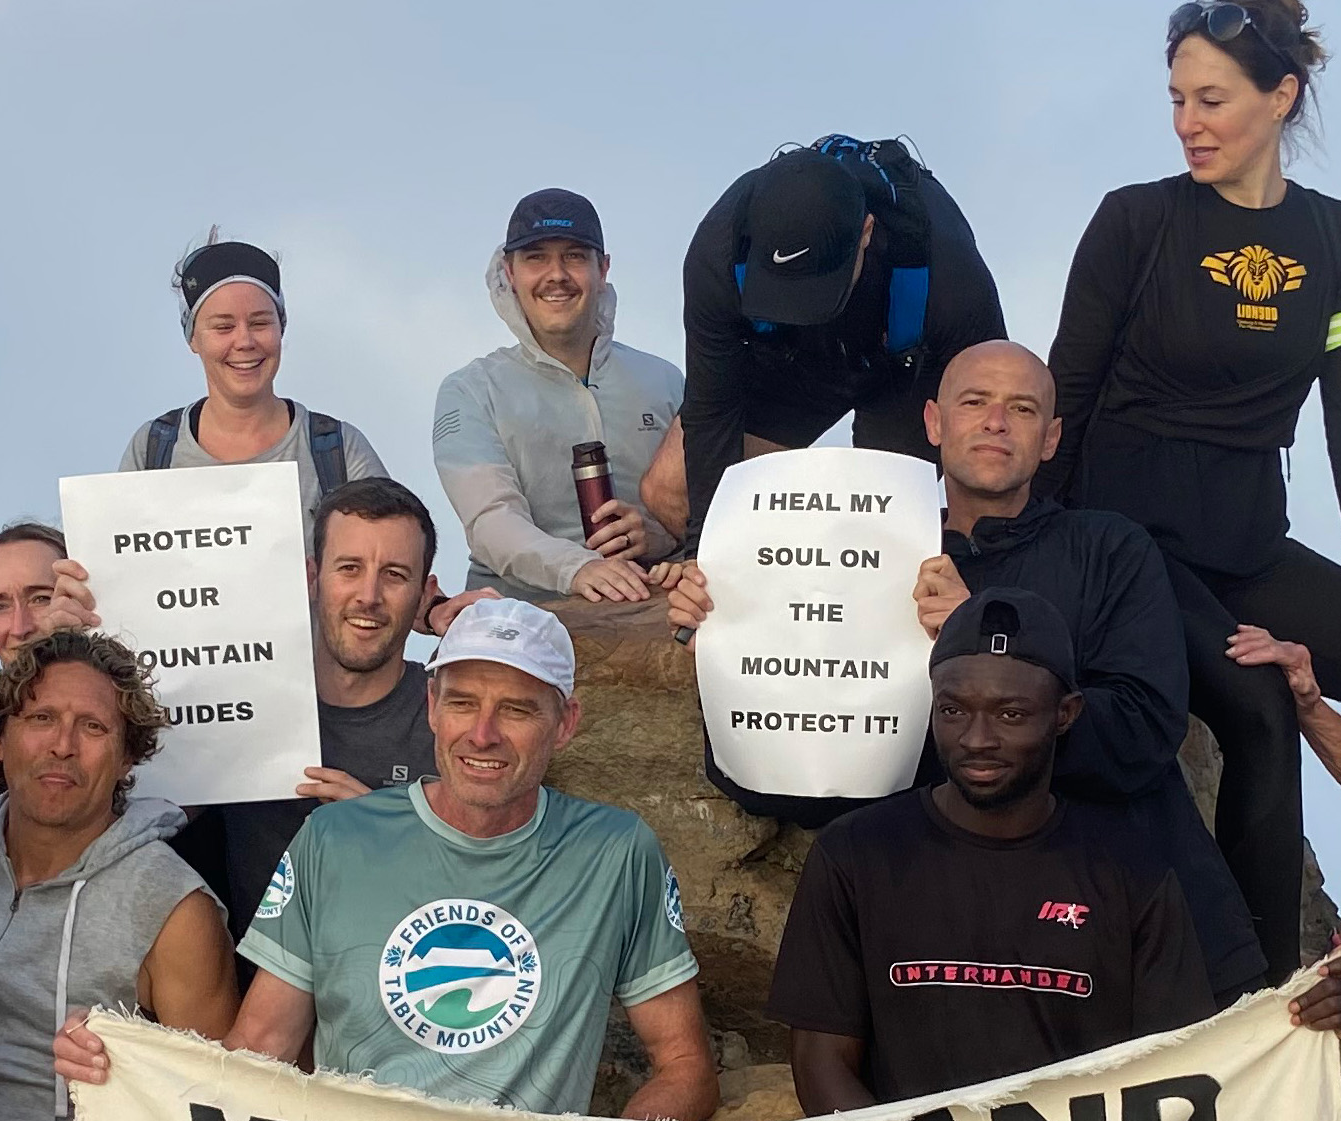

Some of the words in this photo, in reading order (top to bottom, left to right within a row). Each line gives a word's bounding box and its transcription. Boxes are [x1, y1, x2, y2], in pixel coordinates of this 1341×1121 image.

[752, 494, 761, 511] I
[769, 493, 841, 512] HEAL
[850, 494, 893, 513] MY
[114, 525, 252, 555] PROTECT
[757, 547, 831, 567] SOUL
[840, 549, 880, 569] ON
[156, 586, 220, 611] OUR
[789, 603, 844, 623] THE
[137, 641, 274, 670] OUNTAIN
[741, 656, 890, 679] MOUNTAIN
[168, 702, 254, 726] UIDES
[730, 710, 855, 733] PROTECT
[864, 715, 899, 735] IT!
[400, 904, 494, 946] FRIENDS
[500, 922, 526, 946] OF
[894, 965, 1088, 993] INTERHANDEL
[384, 975, 429, 1039] TABLE
[436, 978, 535, 1048] MOUNTAIN
